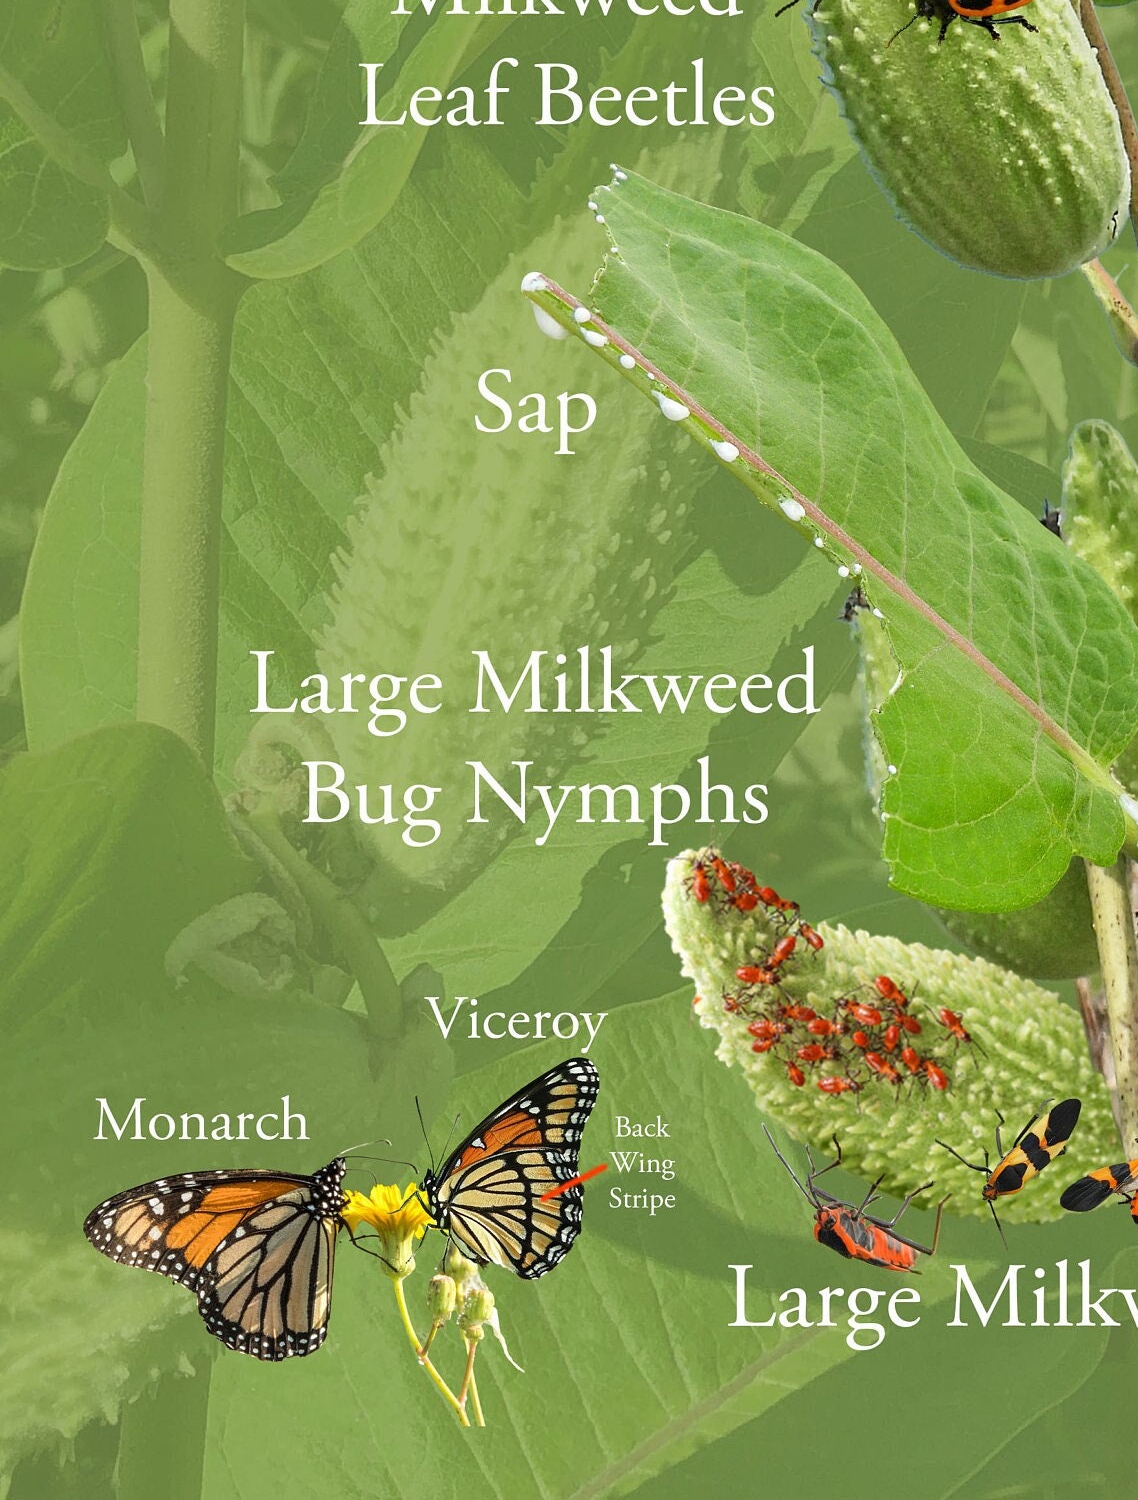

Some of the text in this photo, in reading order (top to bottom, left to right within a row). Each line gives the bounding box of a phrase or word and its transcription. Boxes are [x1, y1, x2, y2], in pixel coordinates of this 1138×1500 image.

[358, 57, 775, 126] Leaf Beetles
[474, 368, 597, 455] Sap
[249, 645, 821, 737] Large Milkweed
[301, 755, 769, 847] Bug Nymphs
[424, 996, 609, 1054] Viceroy
[94, 1095, 310, 1141] Monarch
[616, 1115, 669, 1137] Back
[610, 1151, 675, 1180] Wing
[610, 1188, 674, 1216] Stripe
[728, 1264, 921, 1350] Large
